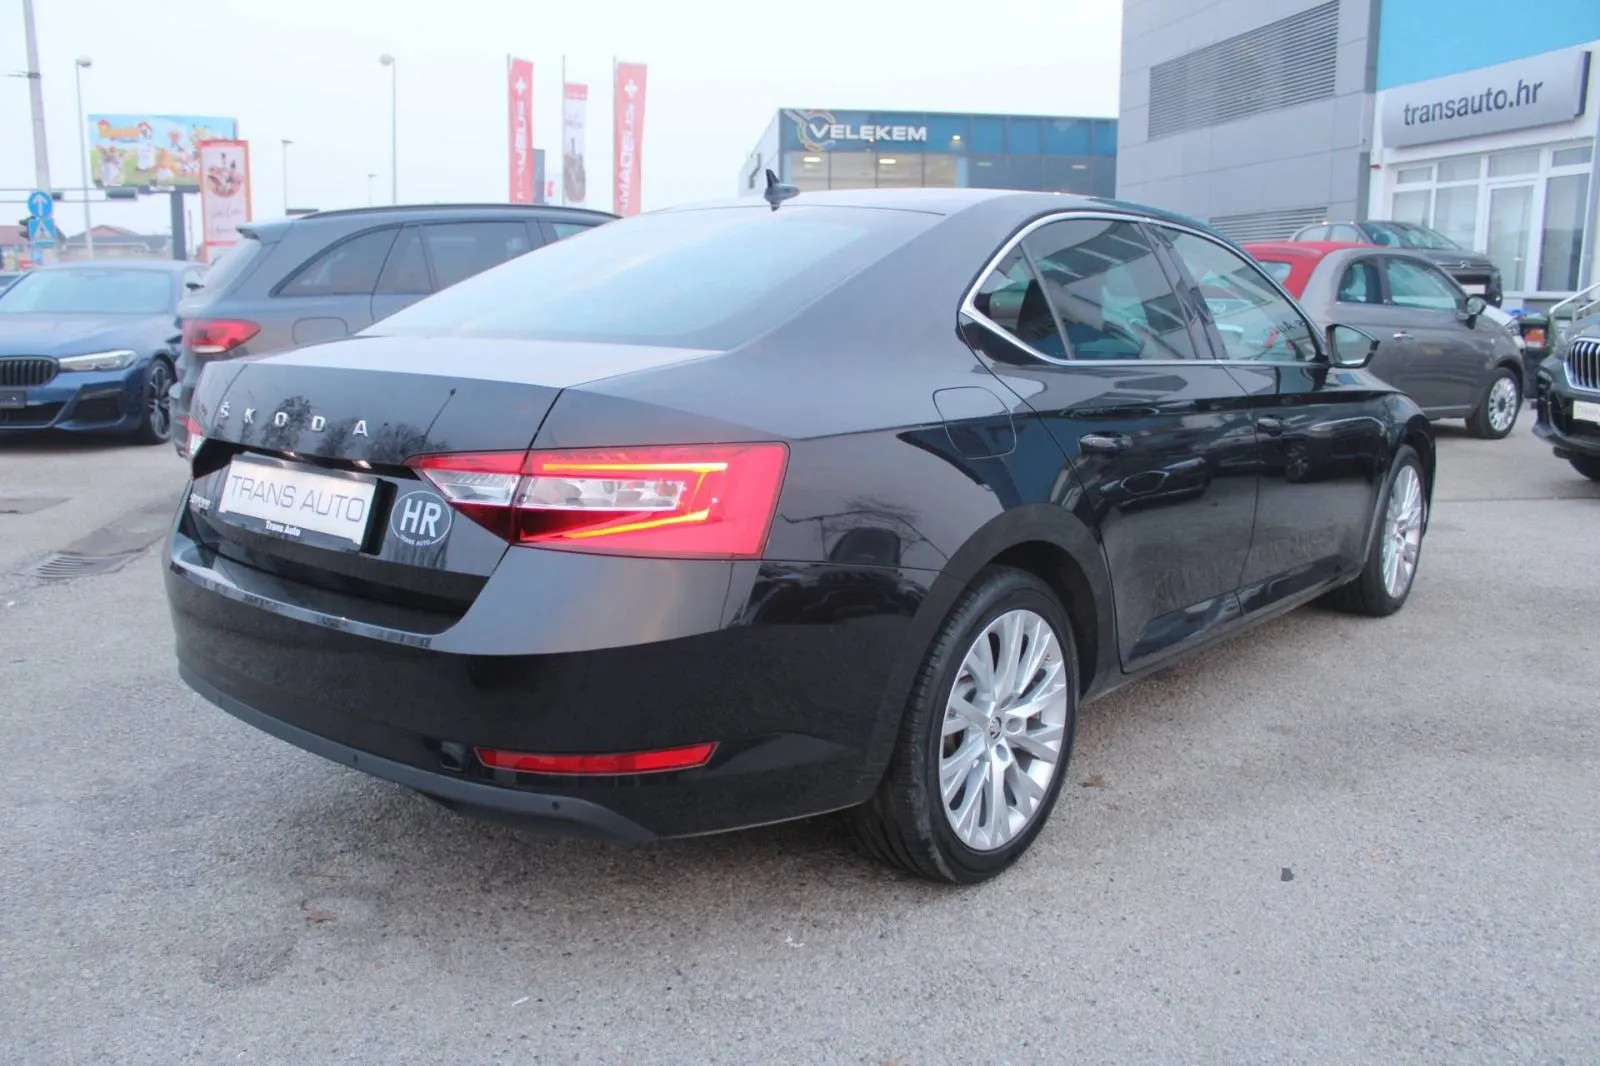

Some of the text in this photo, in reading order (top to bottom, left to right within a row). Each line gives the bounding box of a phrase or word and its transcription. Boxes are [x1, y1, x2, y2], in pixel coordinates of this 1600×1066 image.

[1403, 79, 1543, 126] transauto.hr
[809, 123, 928, 142] VELEKEM
[219, 401, 369, 437] ŠKODA
[231, 475, 298, 510] TRANS
[300, 487, 366, 523] AUTO
[400, 498, 442, 538] HR
[265, 520, 301, 536] Trans Auto
